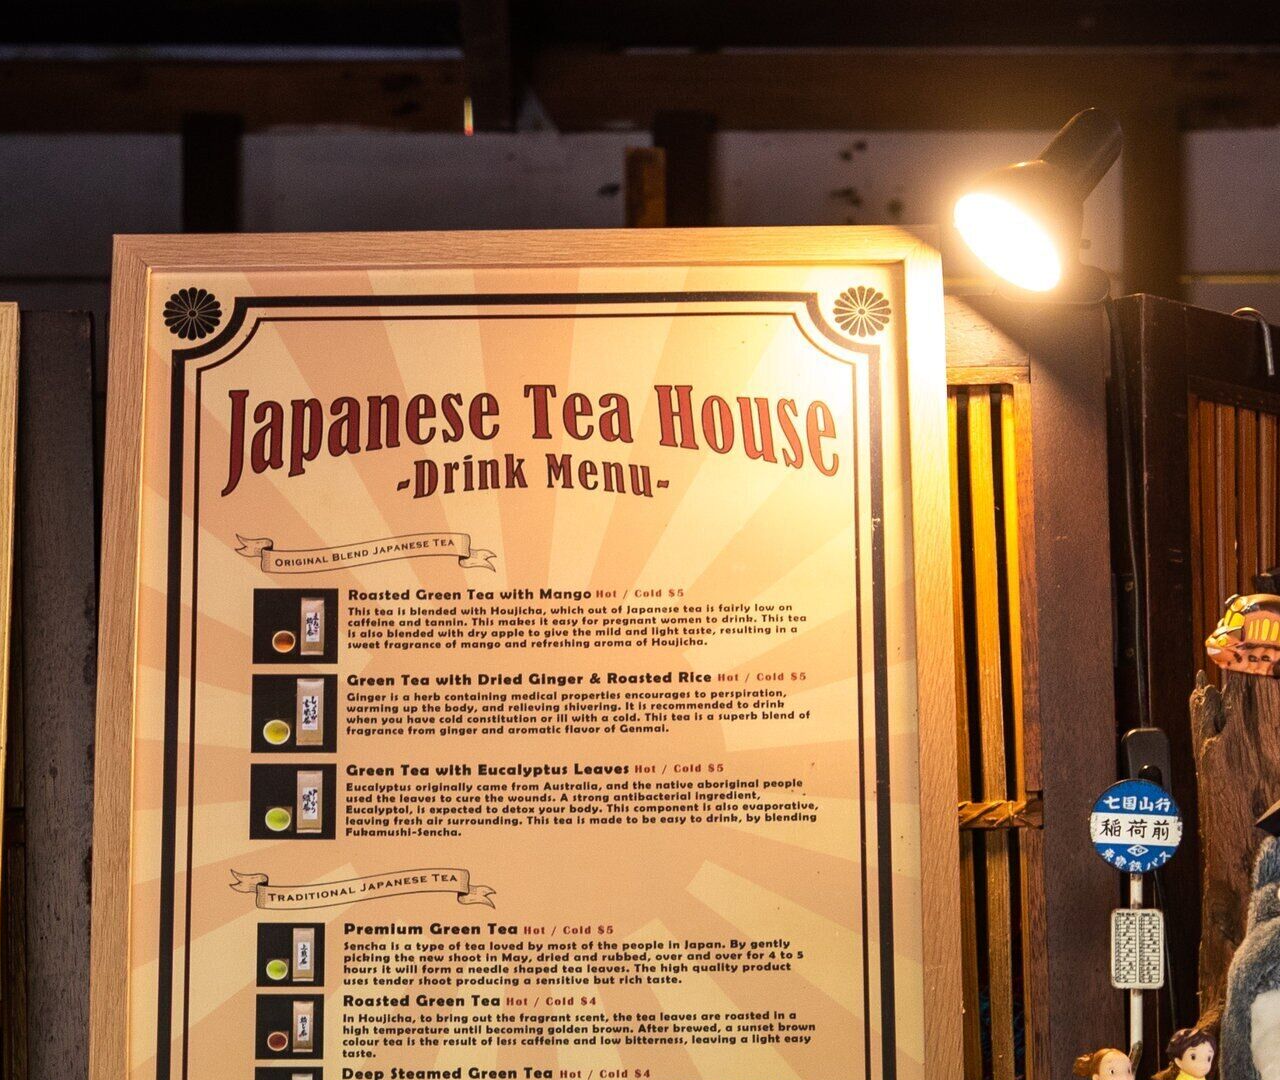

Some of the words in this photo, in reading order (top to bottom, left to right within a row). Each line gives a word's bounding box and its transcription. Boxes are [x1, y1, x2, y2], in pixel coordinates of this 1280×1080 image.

[220, 389, 501, 497] Japanese
[522, 383, 634, 444] Tea
[653, 384, 842, 478] House
[395, 454, 528, 500] -Drink
[547, 454, 671, 500] Menu-
[275, 555, 328, 567] ORIGINAL
[332, 548, 369, 562] BLEND
[372, 539, 429, 555] JAPANESE
[434, 538, 454, 548] TEA
[348, 588, 410, 602] Roasted
[415, 588, 462, 602] Green
[466, 588, 494, 601] Tea
[499, 587, 534, 600] with
[539, 587, 592, 602] Mango
[595, 589, 617, 598] Hot
[634, 588, 663, 598] Cold
[668, 588, 685, 598] $5
[1103, 796, 1171, 812] 七国山行
[1100, 818, 1170, 841] 稲荷前
[267, 884, 355, 904] TRADITIONAL
[360, 874, 428, 894] JAPANESE
[431, 873, 458, 884] TEA
[343, 921, 423, 935] Premium
[429, 921, 481, 935] Green
[487, 921, 518, 935] Tea
[342, 1048, 377, 1058] taste.
[390, 1066, 462, 1080] Steamed
[468, 1066, 518, 1080] Green
[523, 1066, 553, 1080] Tea
